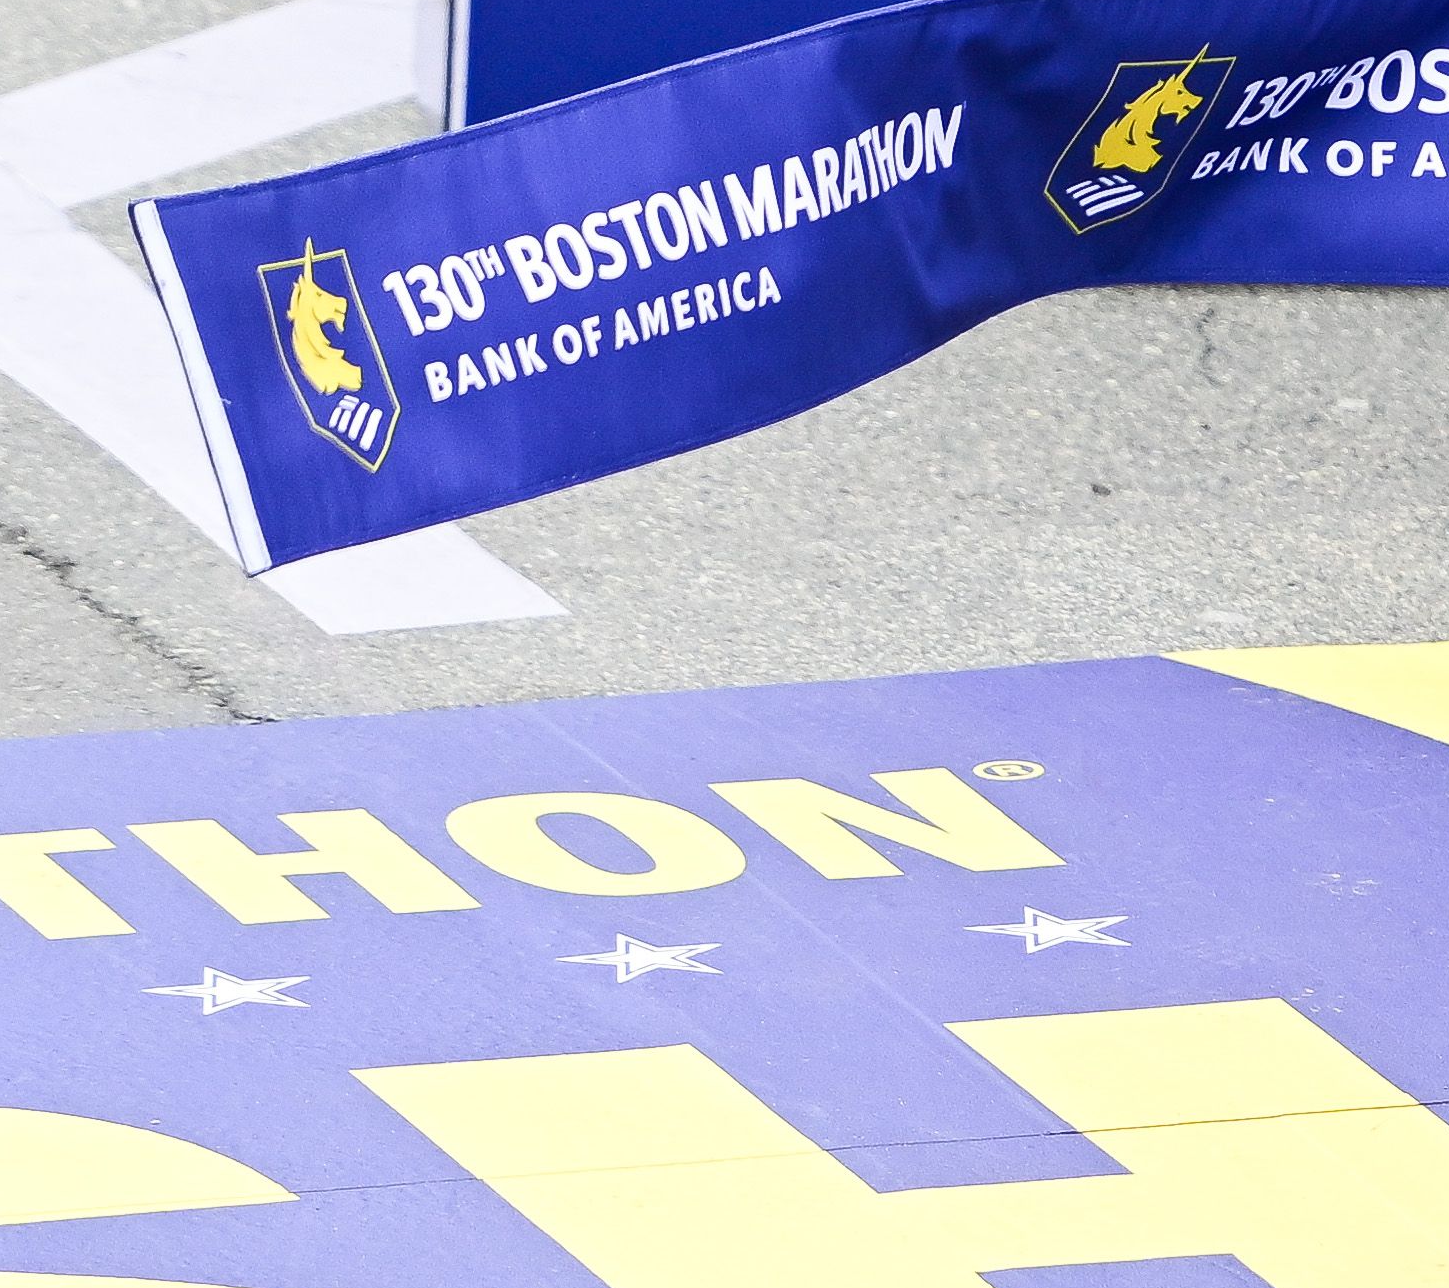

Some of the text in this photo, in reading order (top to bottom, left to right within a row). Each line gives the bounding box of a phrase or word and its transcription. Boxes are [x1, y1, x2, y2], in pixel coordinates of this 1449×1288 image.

[1225, 64, 1347, 130] 130TH
[1191, 137, 1309, 180] BANK
[1326, 140, 1397, 178] OF
[382, 105, 964, 337] 130TH BOSTON MARATHON
[423, 266, 782, 402] BANK OF AMERICA
